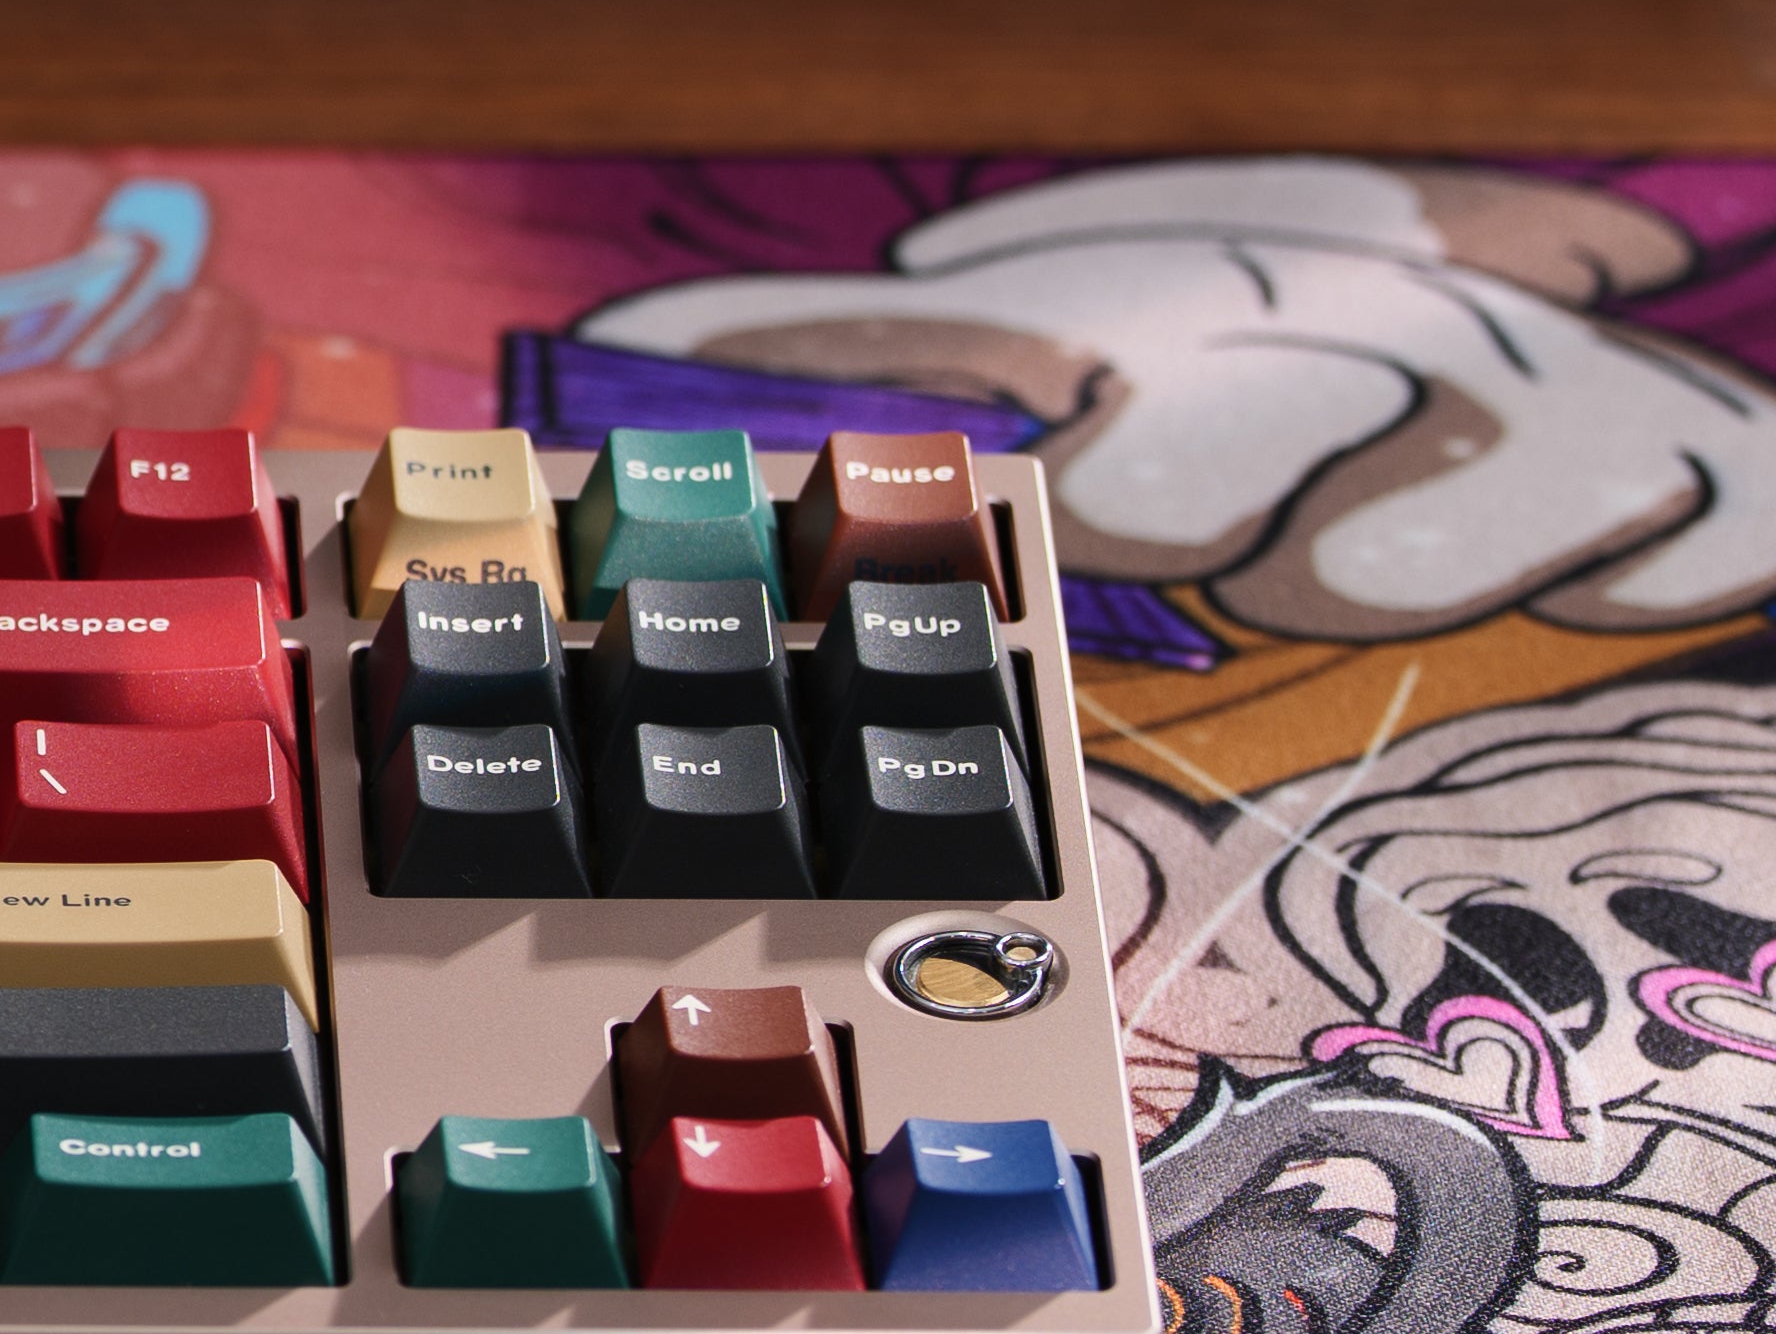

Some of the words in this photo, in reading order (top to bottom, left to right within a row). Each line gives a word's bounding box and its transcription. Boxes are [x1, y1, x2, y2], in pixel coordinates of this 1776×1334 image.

[131, 460, 189, 480] F12
[407, 462, 492, 479] Print
[627, 461, 732, 481] Scroll
[847, 462, 955, 483] Pause
[419, 612, 523, 633] Insert
[639, 611, 740, 632] Home
[37, 729, 46, 755] |
[427, 755, 542, 774] Delete
[653, 756, 721, 775] End
[40, 769, 66, 794] \
[62, 894, 131, 906] Line
[60, 1139, 200, 1157] Control
